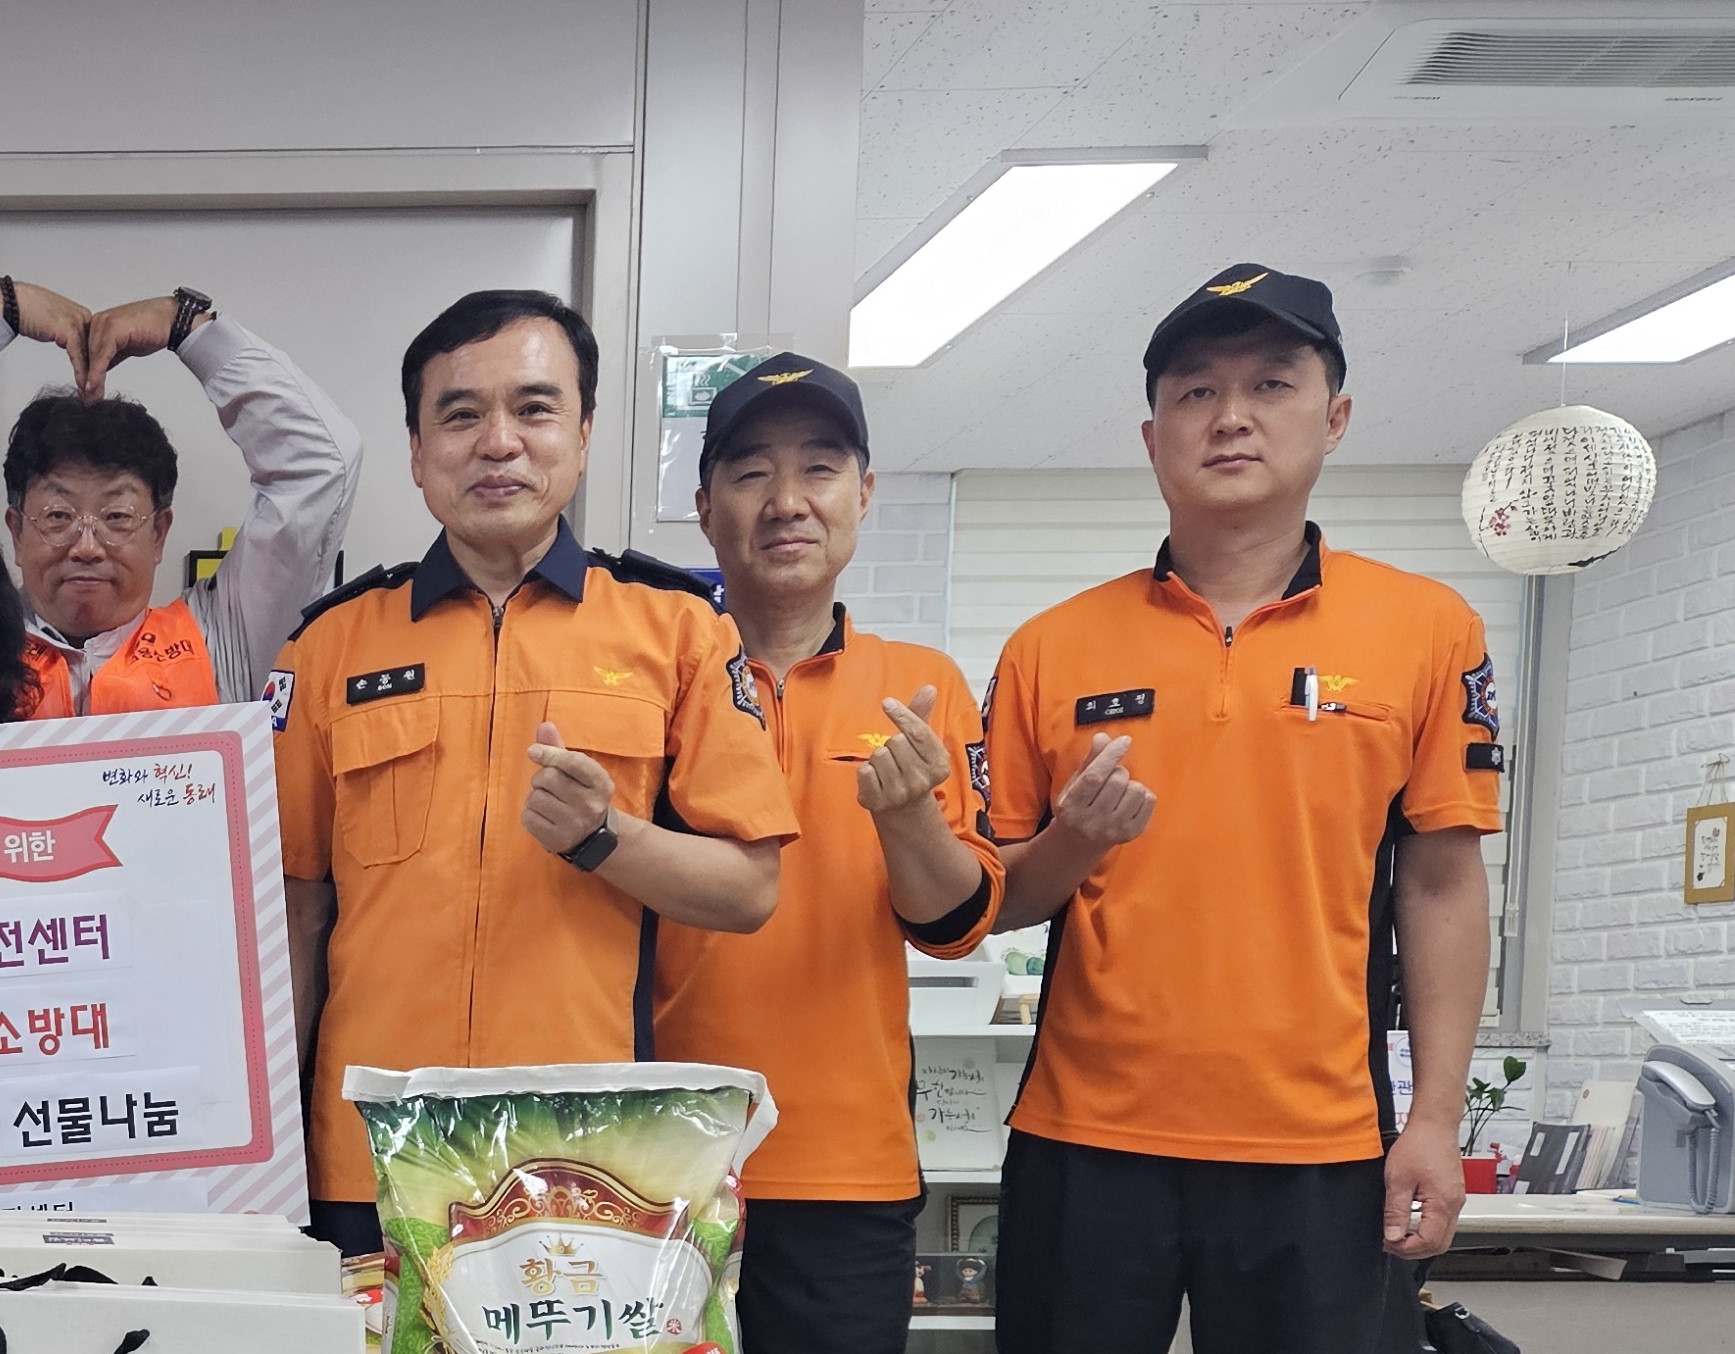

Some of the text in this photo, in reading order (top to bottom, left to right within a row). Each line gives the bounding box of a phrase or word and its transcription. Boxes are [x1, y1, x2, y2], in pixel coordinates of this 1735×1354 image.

[102, 763, 193, 786] 변화와 혁신!
[137, 783, 216, 808] 새로운 동래
[4, 830, 56, 863] 위한
[13, 1092, 180, 1148] 선물나눔
[520, 1257, 605, 1296] 황금
[482, 1298, 664, 1345] 메뚜기쌀
